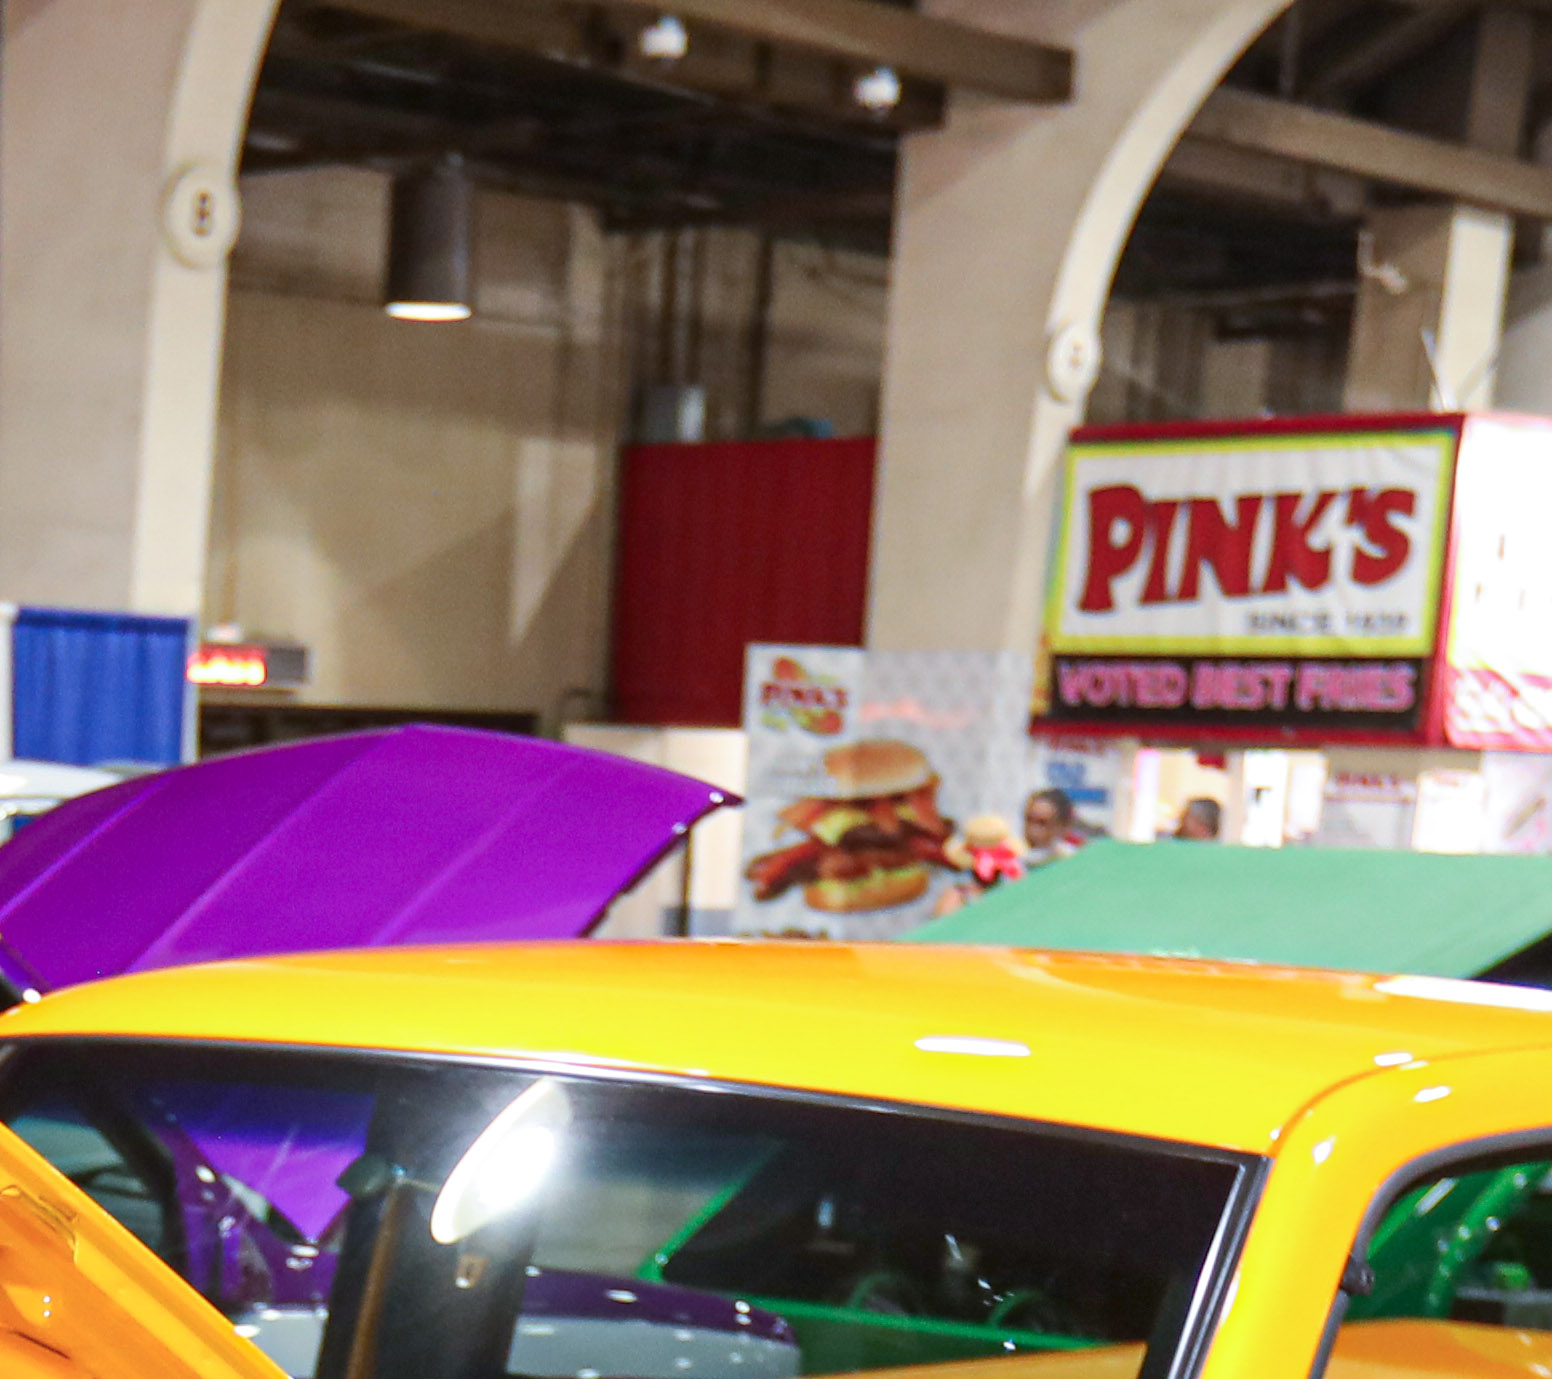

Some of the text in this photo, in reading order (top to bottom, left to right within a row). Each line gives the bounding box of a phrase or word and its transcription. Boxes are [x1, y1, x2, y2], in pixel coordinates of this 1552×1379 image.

[1076, 482, 1417, 613] PINK'S
[1057, 660, 1416, 712] VOTED BEST FRIES
